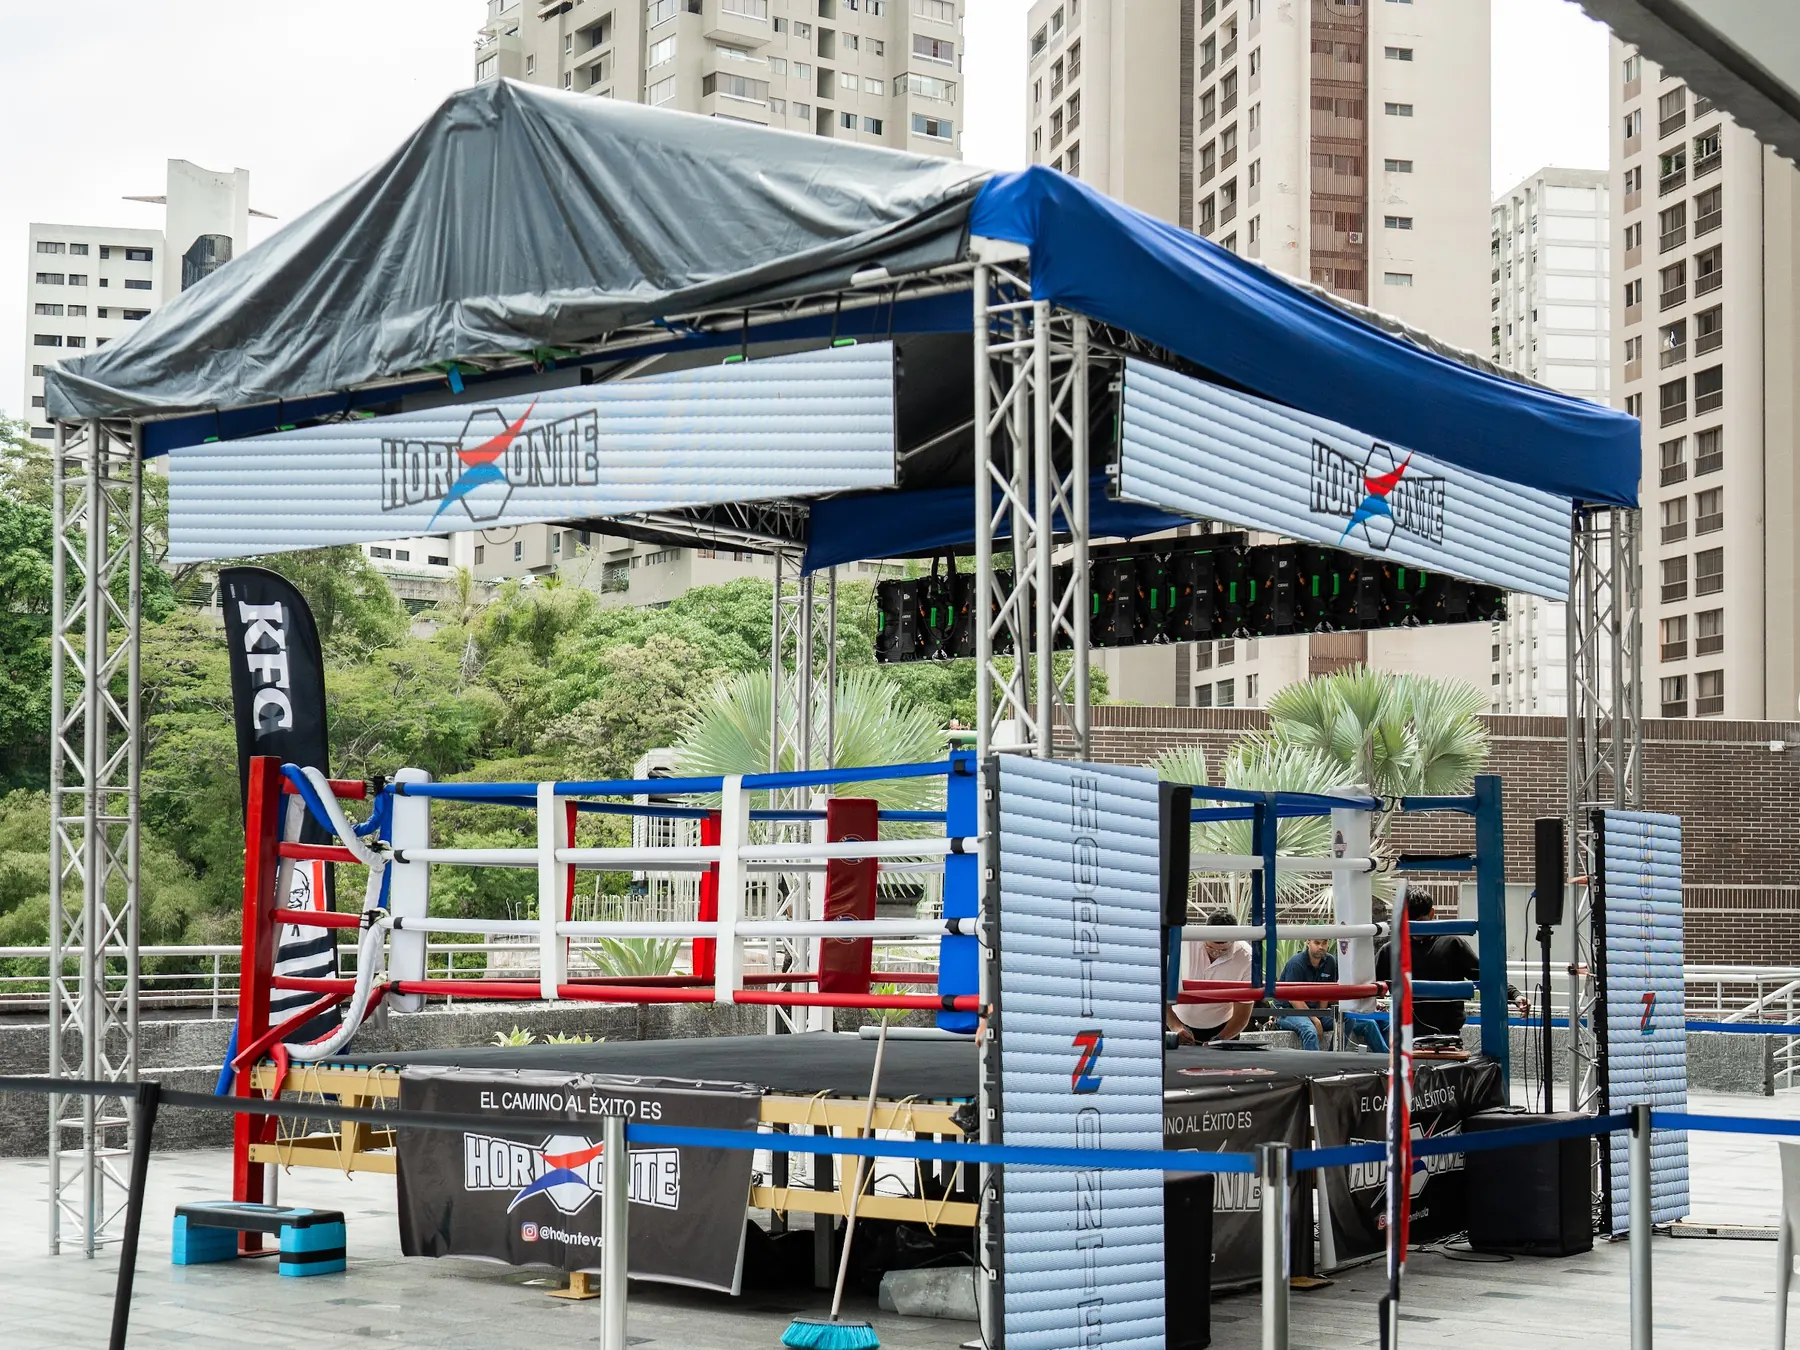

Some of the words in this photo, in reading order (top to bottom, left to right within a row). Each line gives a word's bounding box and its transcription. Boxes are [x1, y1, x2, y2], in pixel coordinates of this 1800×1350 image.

[238, 600, 293, 730] KFC
[480, 1091, 499, 1109] EL
[502, 1091, 564, 1111] CAMINO
[564, 1094, 586, 1114] AL
[589, 1093, 636, 1118] ÉXITO
[640, 1100, 662, 1120] ES
[1361, 1096, 1371, 1112] EL
[1415, 1095, 1426, 1111] AL
[1425, 1089, 1448, 1109] ÉXITO
[1164, 1116, 1184, 1135] INO
[1186, 1115, 1200, 1133] AL
[1203, 1110, 1235, 1132] ÉXITO
[1238, 1111, 1252, 1129] ES
